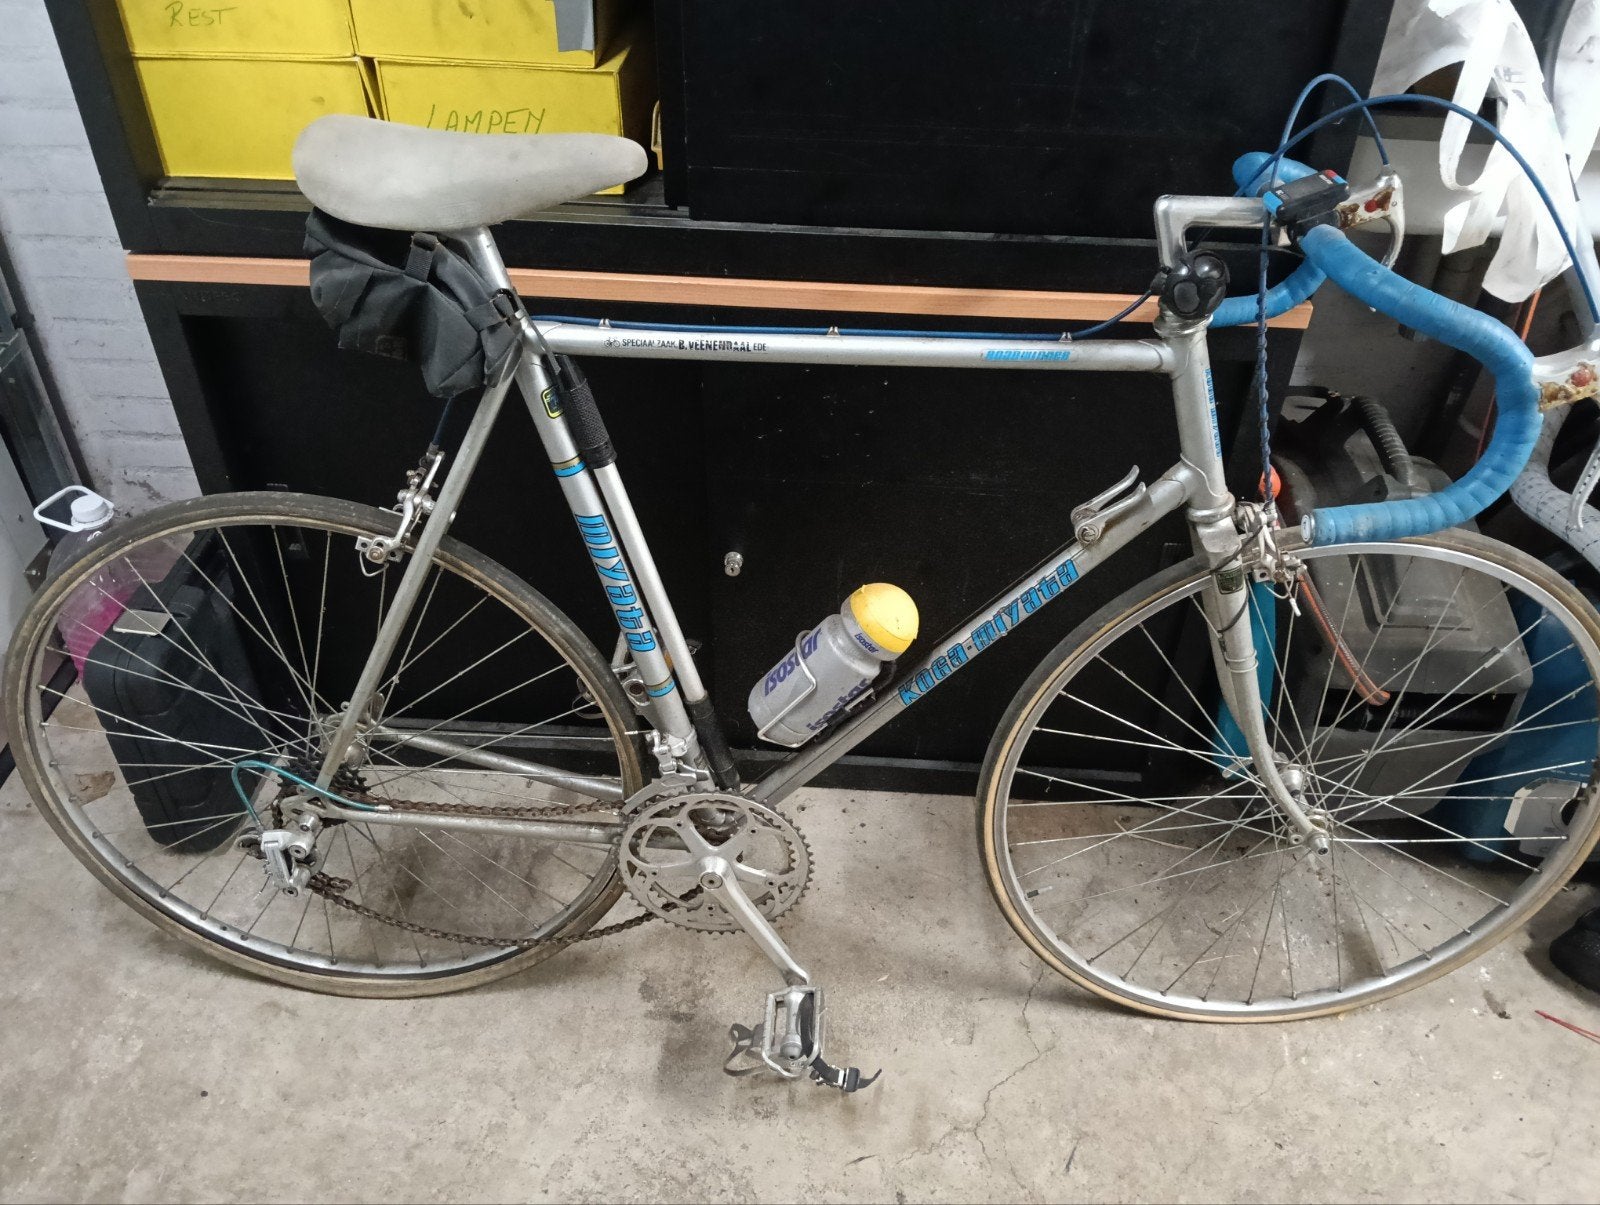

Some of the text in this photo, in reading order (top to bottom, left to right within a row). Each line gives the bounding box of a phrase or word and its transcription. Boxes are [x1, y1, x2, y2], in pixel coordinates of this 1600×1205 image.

[164, 0, 238, 27] REST
[753, 343, 767, 351] EDE
[855, 632, 879, 654] isostar
